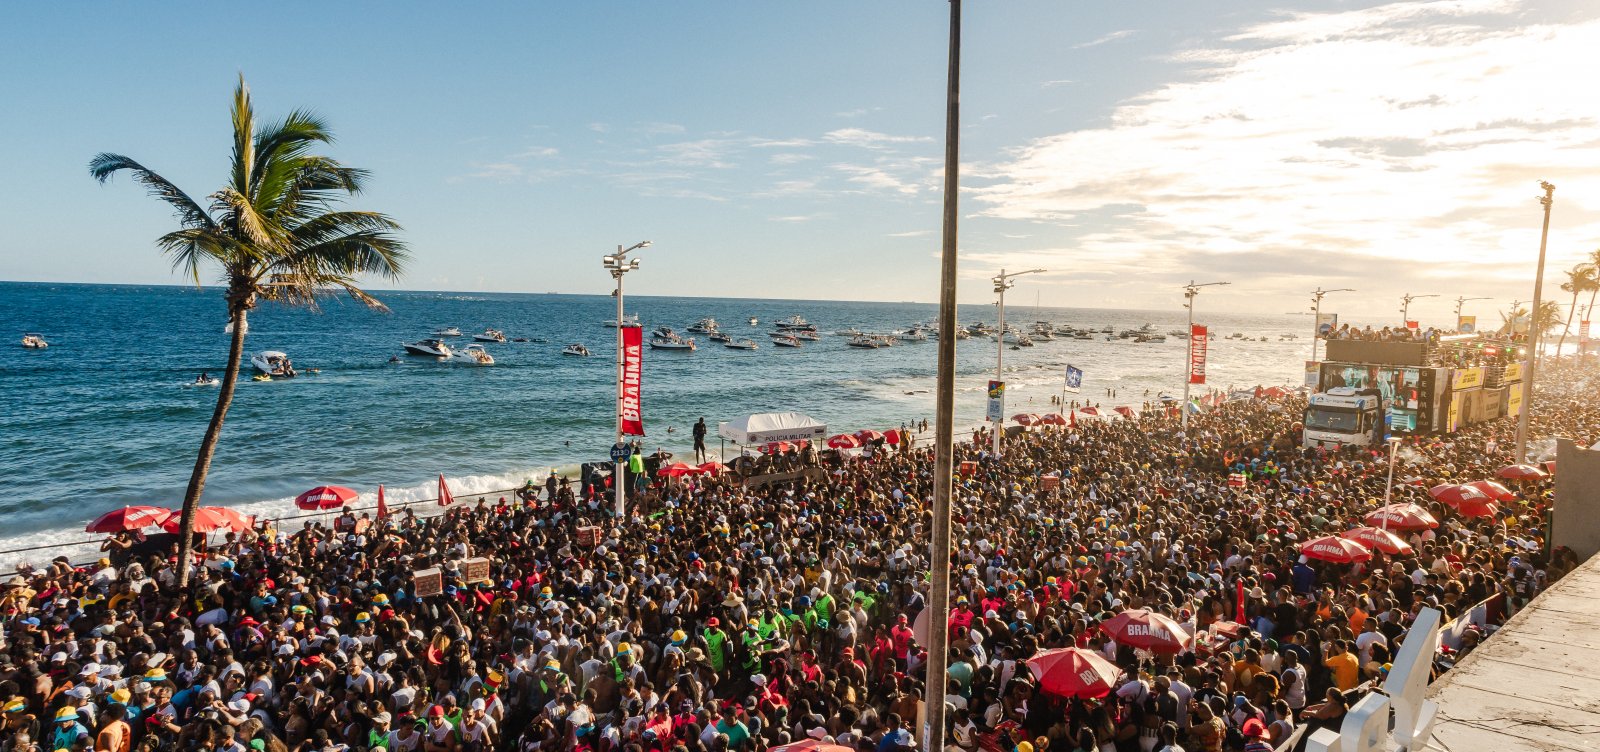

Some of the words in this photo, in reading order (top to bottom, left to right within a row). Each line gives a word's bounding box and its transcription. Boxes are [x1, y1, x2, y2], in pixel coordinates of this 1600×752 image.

[1193, 335, 1206, 376] BRAHMA
[623, 344, 640, 422] BRAHMA
[306, 493, 337, 503] BRAHMA
[1360, 534, 1391, 546] BRAHMA
[1313, 544, 1344, 556] BRAHMA
[1127, 624, 1171, 641] BRAHMA
